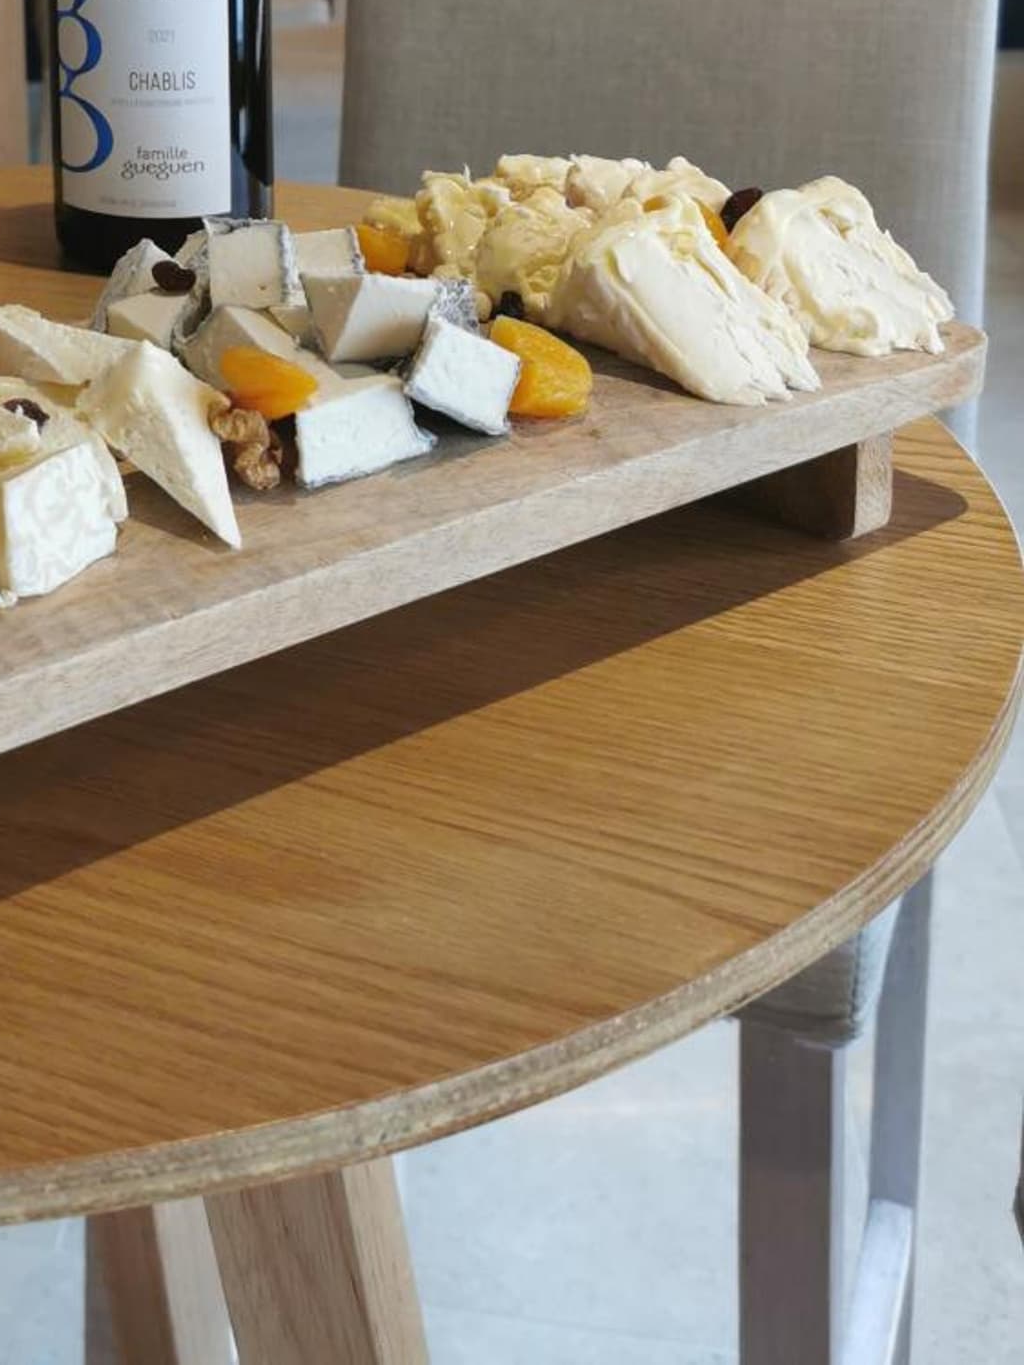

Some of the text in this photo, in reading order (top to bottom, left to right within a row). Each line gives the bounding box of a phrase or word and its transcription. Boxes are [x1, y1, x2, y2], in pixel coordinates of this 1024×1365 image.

[129, 71, 197, 92] CHABLIS
[136, 145, 189, 161] famille
[120, 160, 205, 180] gueguen
